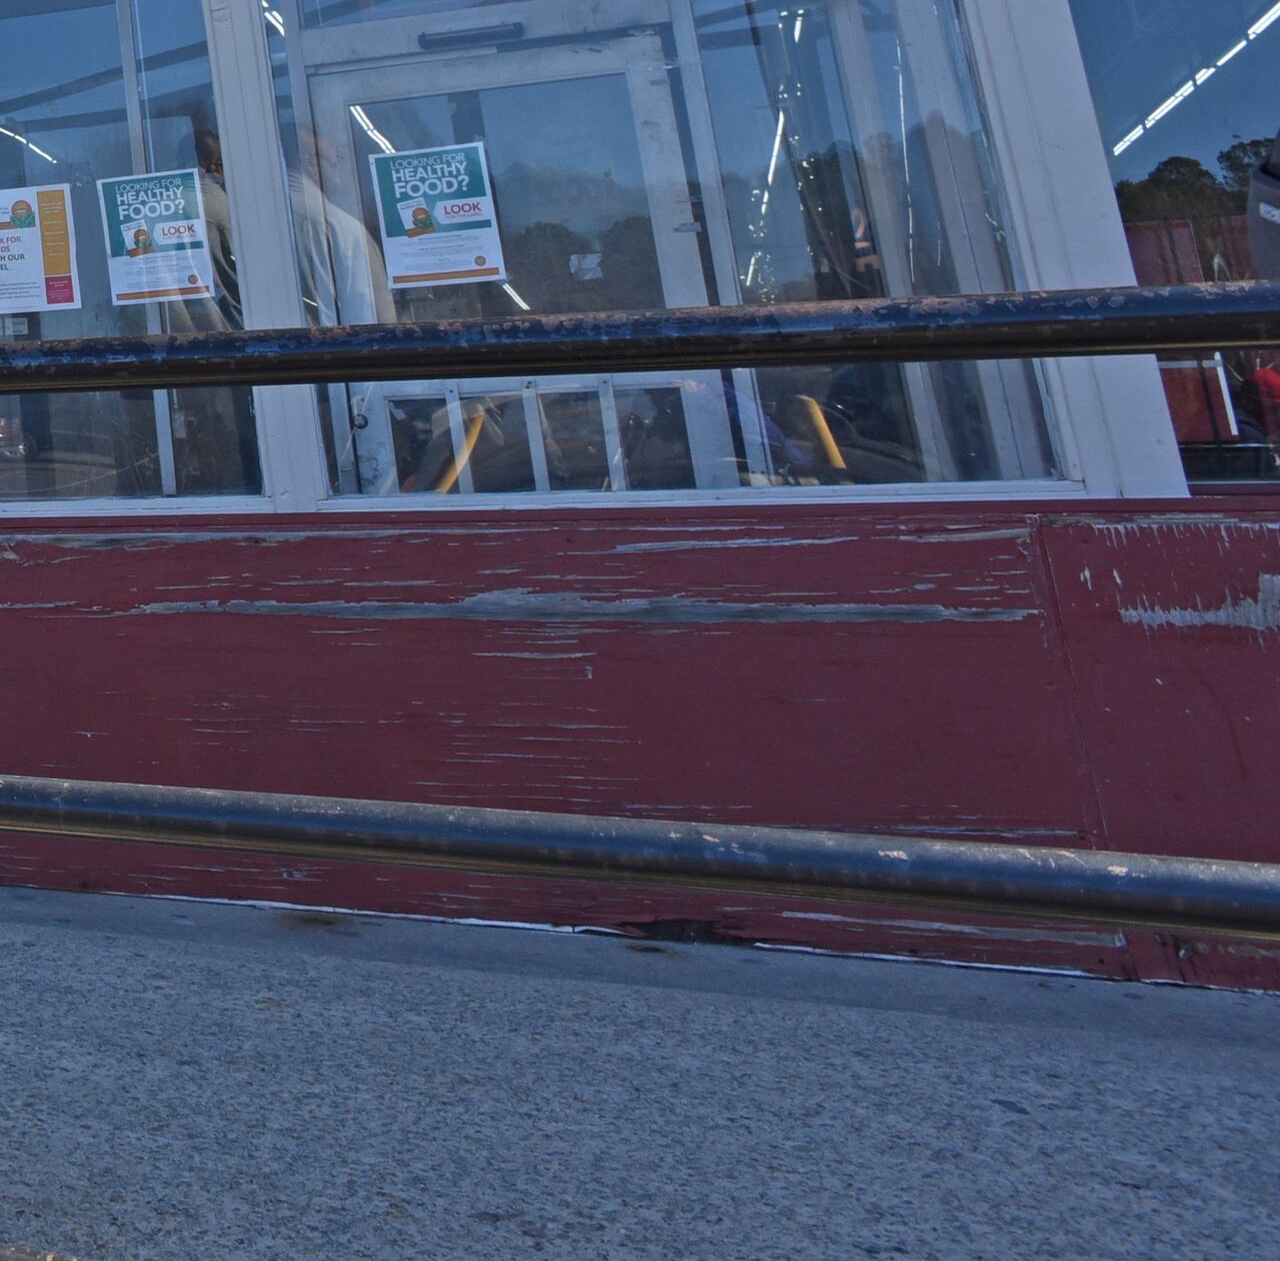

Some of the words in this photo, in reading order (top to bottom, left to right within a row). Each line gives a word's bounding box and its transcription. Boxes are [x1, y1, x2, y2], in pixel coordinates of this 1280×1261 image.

[390, 155, 440, 170] LOOKING
[442, 152, 466, 163] FOR
[391, 161, 468, 183] HEALTHY
[114, 180, 160, 194] LOOKING
[161, 177, 182, 188] FOR
[393, 175, 470, 199] FOOD?
[115, 186, 184, 205] HEALTHY
[118, 199, 185, 221] FOOD?
[443, 202, 482, 216] LOOK
[161, 224, 196, 237] LOOK
[6, 235, 23, 244] FOR
[7, 253, 26, 261] OUR
